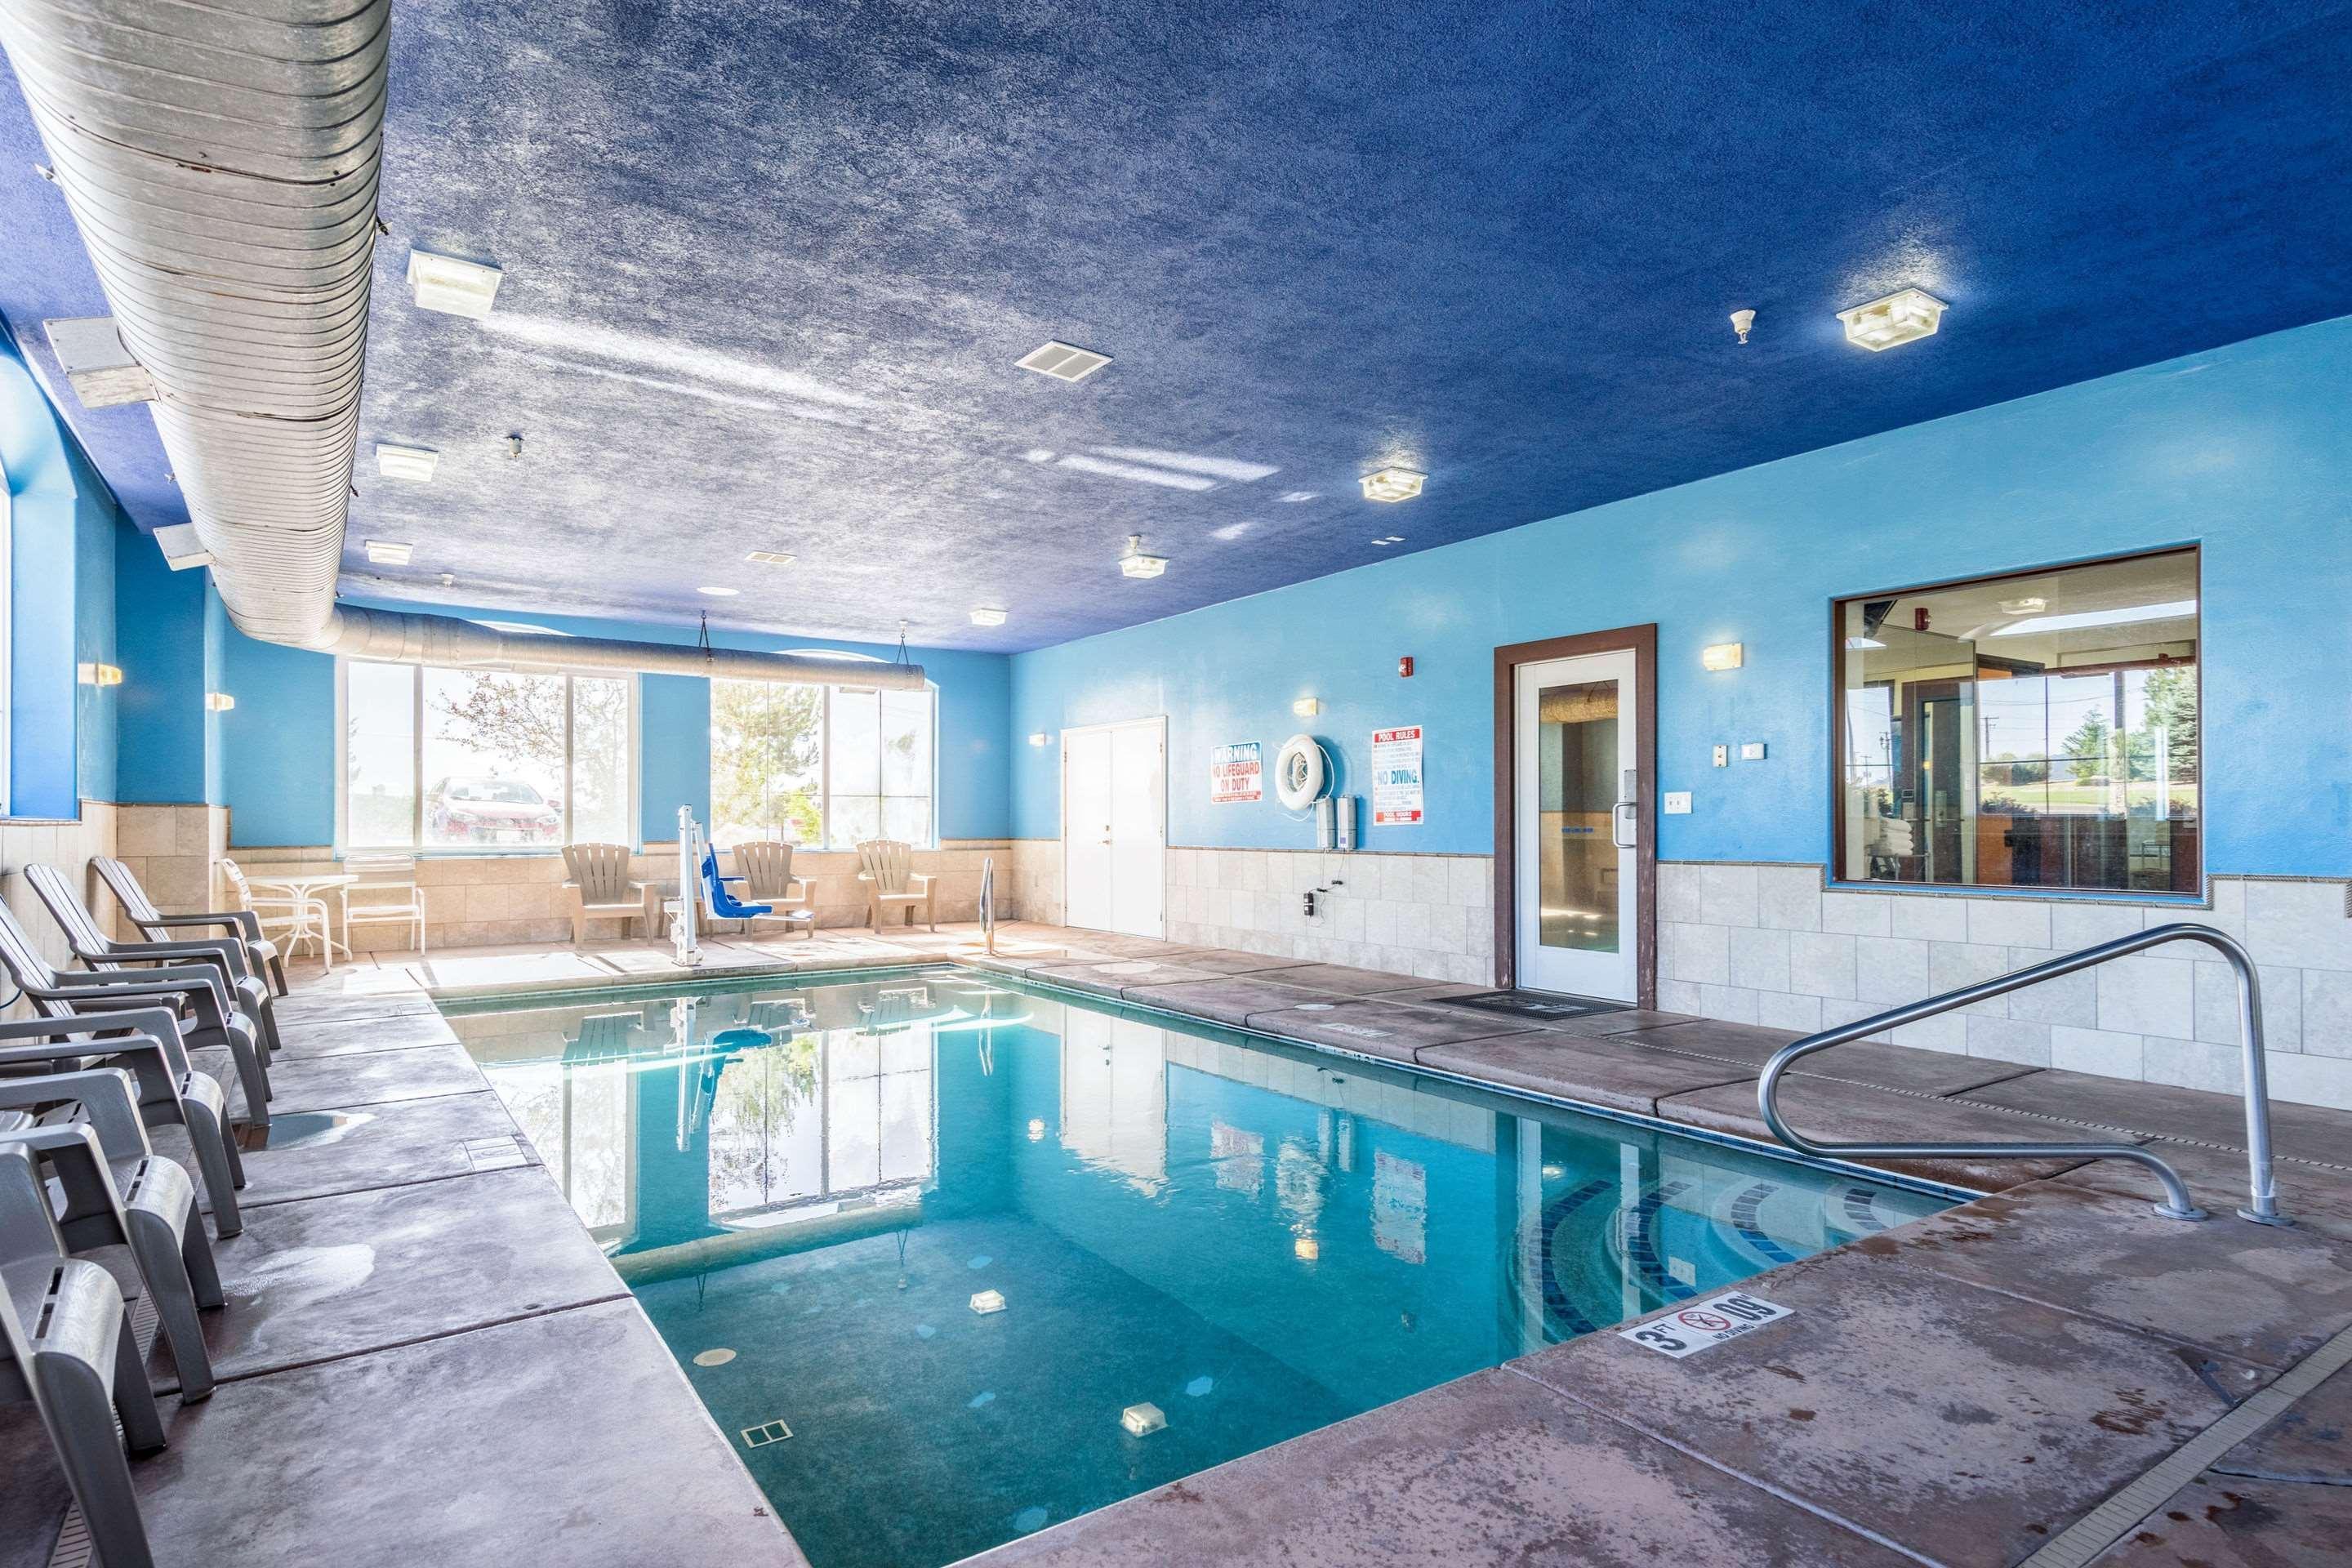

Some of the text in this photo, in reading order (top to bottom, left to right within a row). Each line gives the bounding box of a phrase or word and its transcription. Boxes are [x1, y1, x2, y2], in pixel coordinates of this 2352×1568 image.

[1379, 729, 1415, 742] POOL RULES
[1214, 744, 1258, 763] WARNING
[1223, 762, 1259, 777] LIFEGUARD
[1378, 770, 1388, 784] NO
[1221, 777, 1250, 792] ON DUTY
[1635, 1323, 1688, 1351] 3 FT
[1712, 1323, 1755, 1340] NO DIVING
